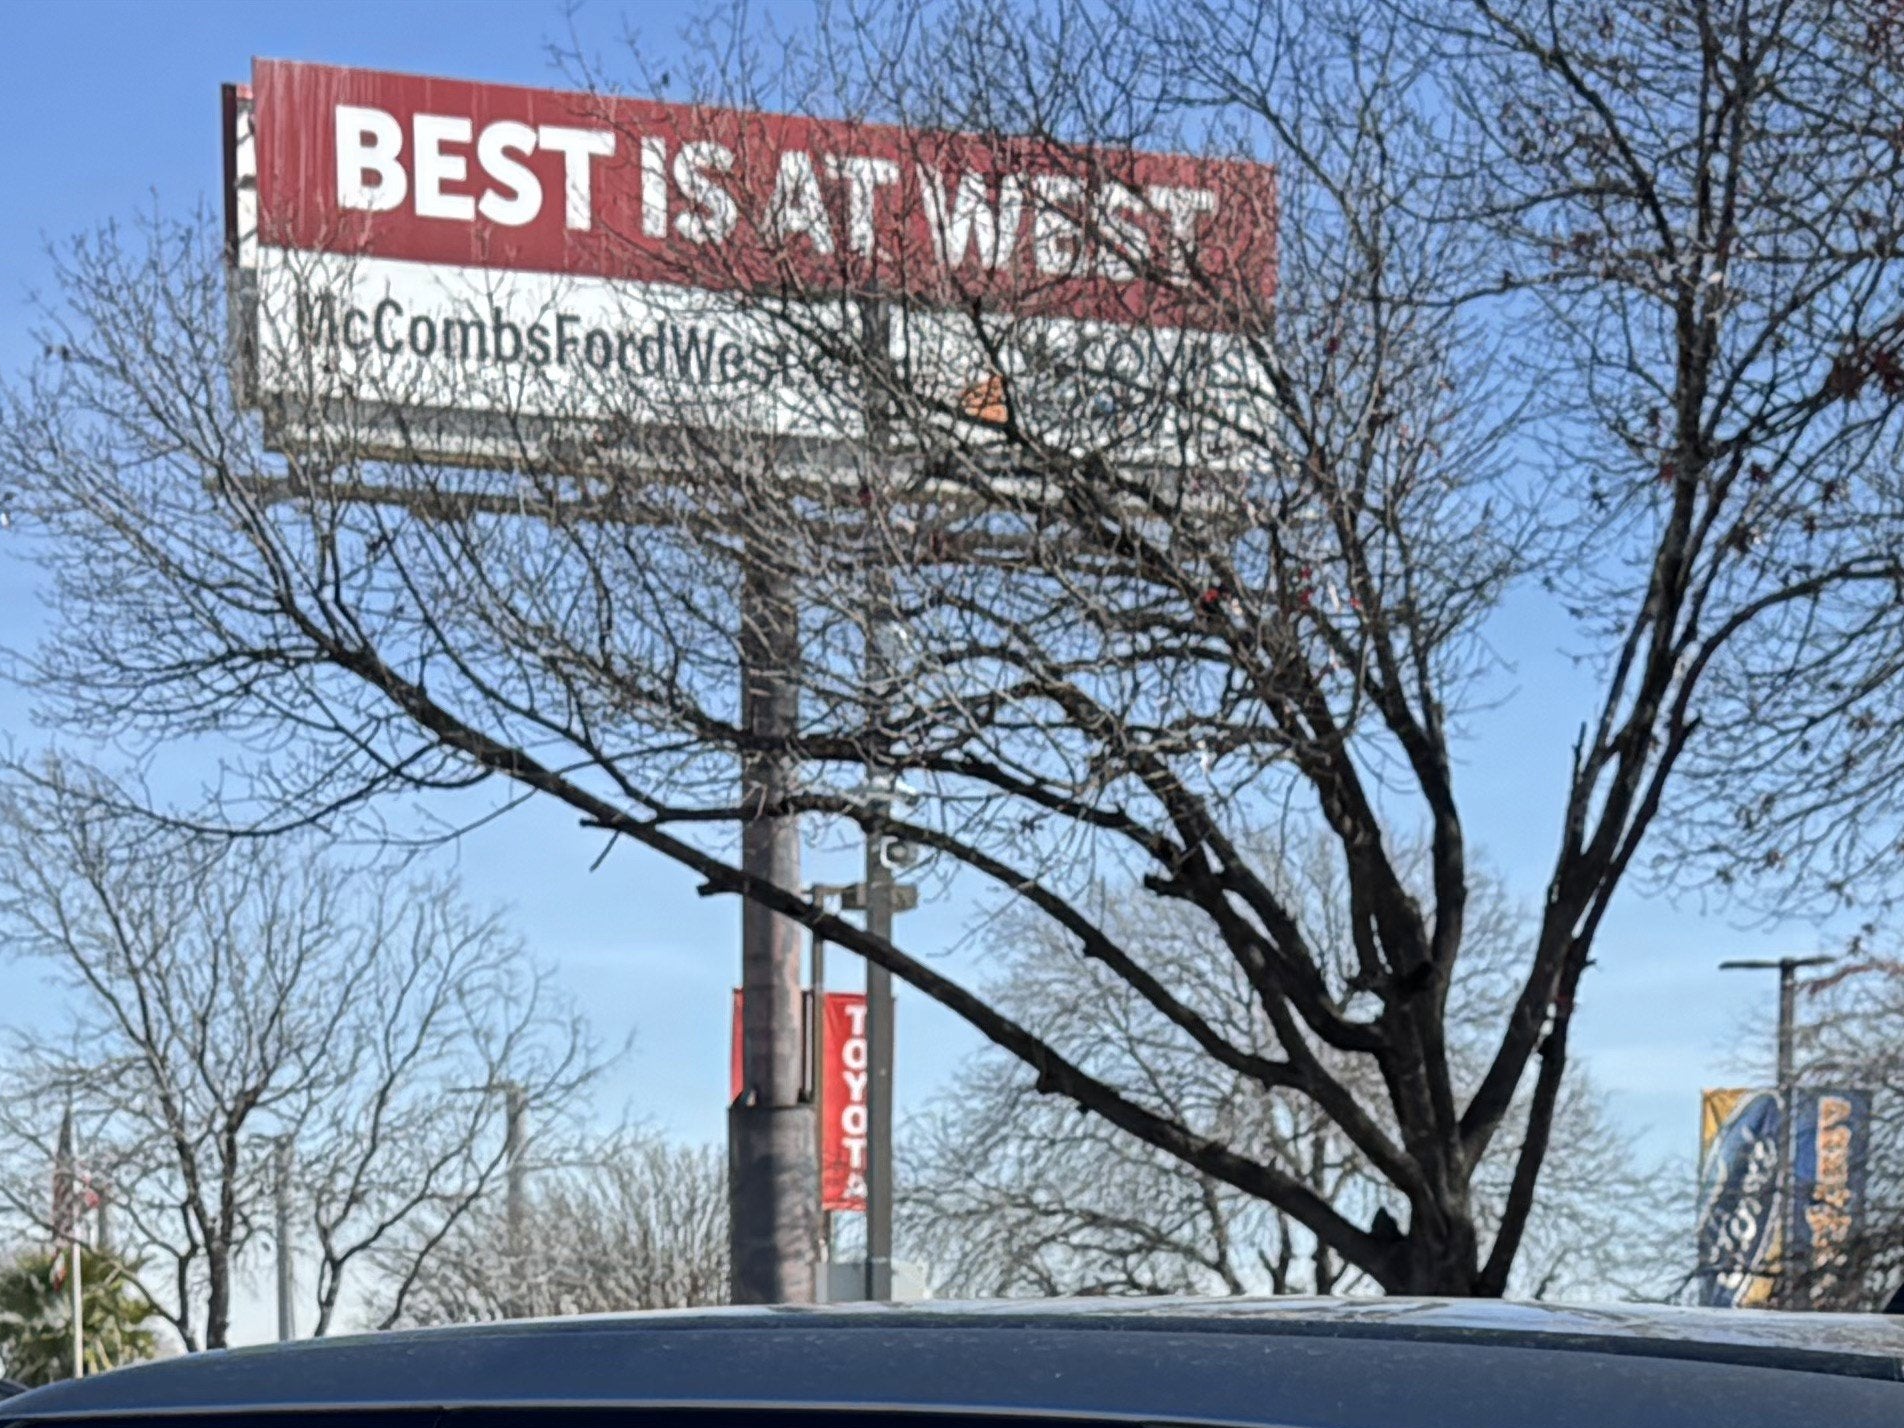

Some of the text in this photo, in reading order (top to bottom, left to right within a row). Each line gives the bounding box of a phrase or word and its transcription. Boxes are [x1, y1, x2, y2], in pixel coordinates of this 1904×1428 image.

[334, 103, 1215, 288] BEST IS AT WEST
[841, 1004, 868, 1199] TOYOTA
